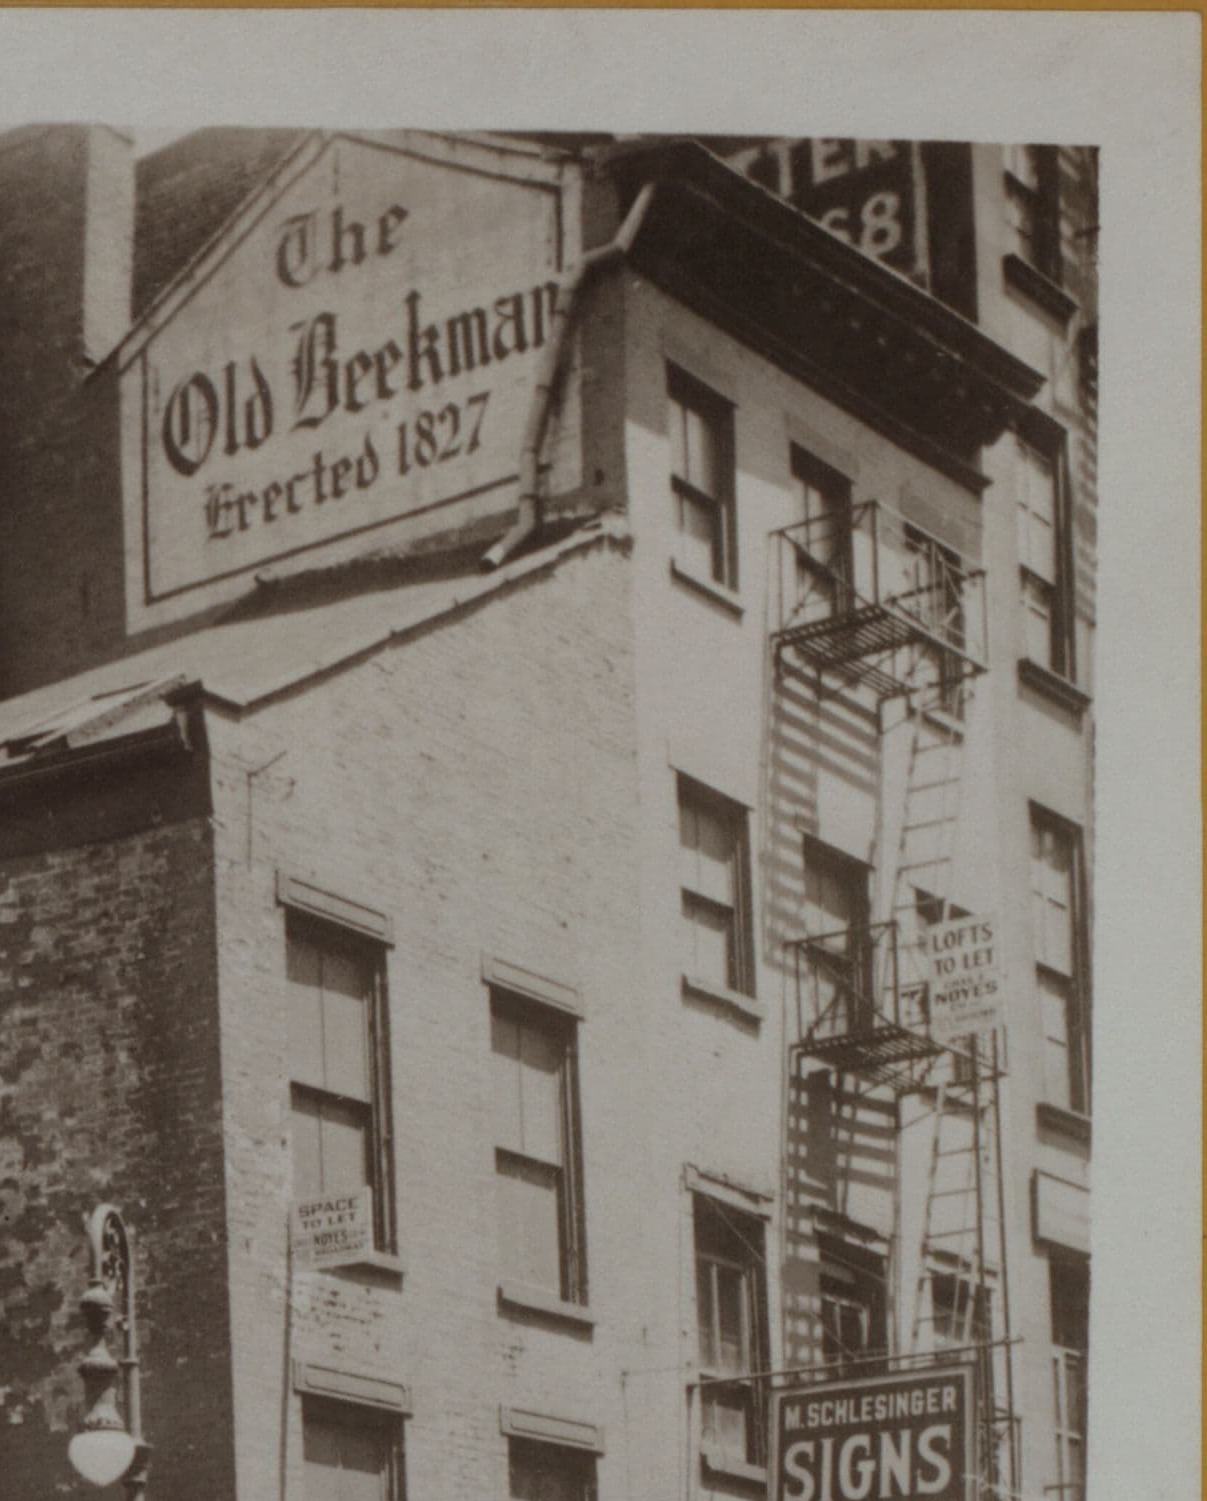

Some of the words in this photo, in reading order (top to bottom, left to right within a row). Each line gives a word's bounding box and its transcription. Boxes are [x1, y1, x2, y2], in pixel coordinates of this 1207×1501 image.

[275, 204, 409, 288] The
[162, 355, 273, 477] Old
[287, 280, 561, 430] Beekman
[203, 433, 379, 539] Erected
[398, 391, 491, 476] 1827
[932, 922, 993, 953] LOFTS
[934, 956, 955, 976] TO
[962, 947, 994, 971] LET
[298, 1197, 359, 1218] SPACE
